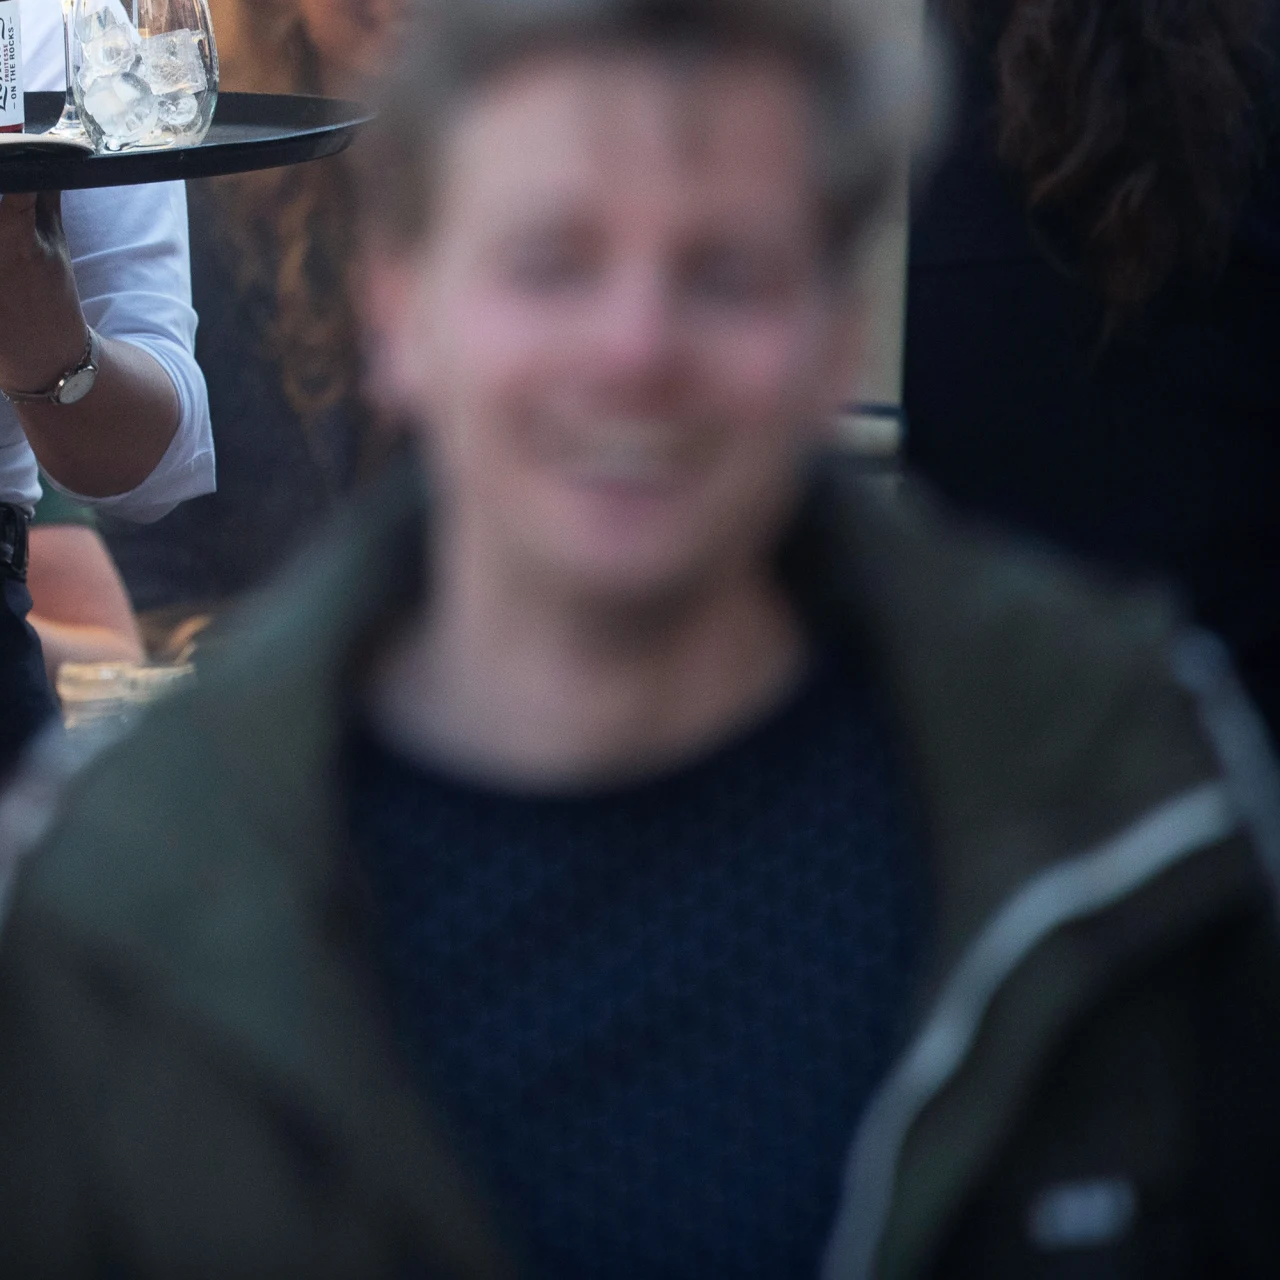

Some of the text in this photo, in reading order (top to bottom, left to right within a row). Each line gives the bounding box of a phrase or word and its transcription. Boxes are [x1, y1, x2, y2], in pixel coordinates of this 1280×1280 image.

[7, 26, 18, 100] ON THE ROCKS
